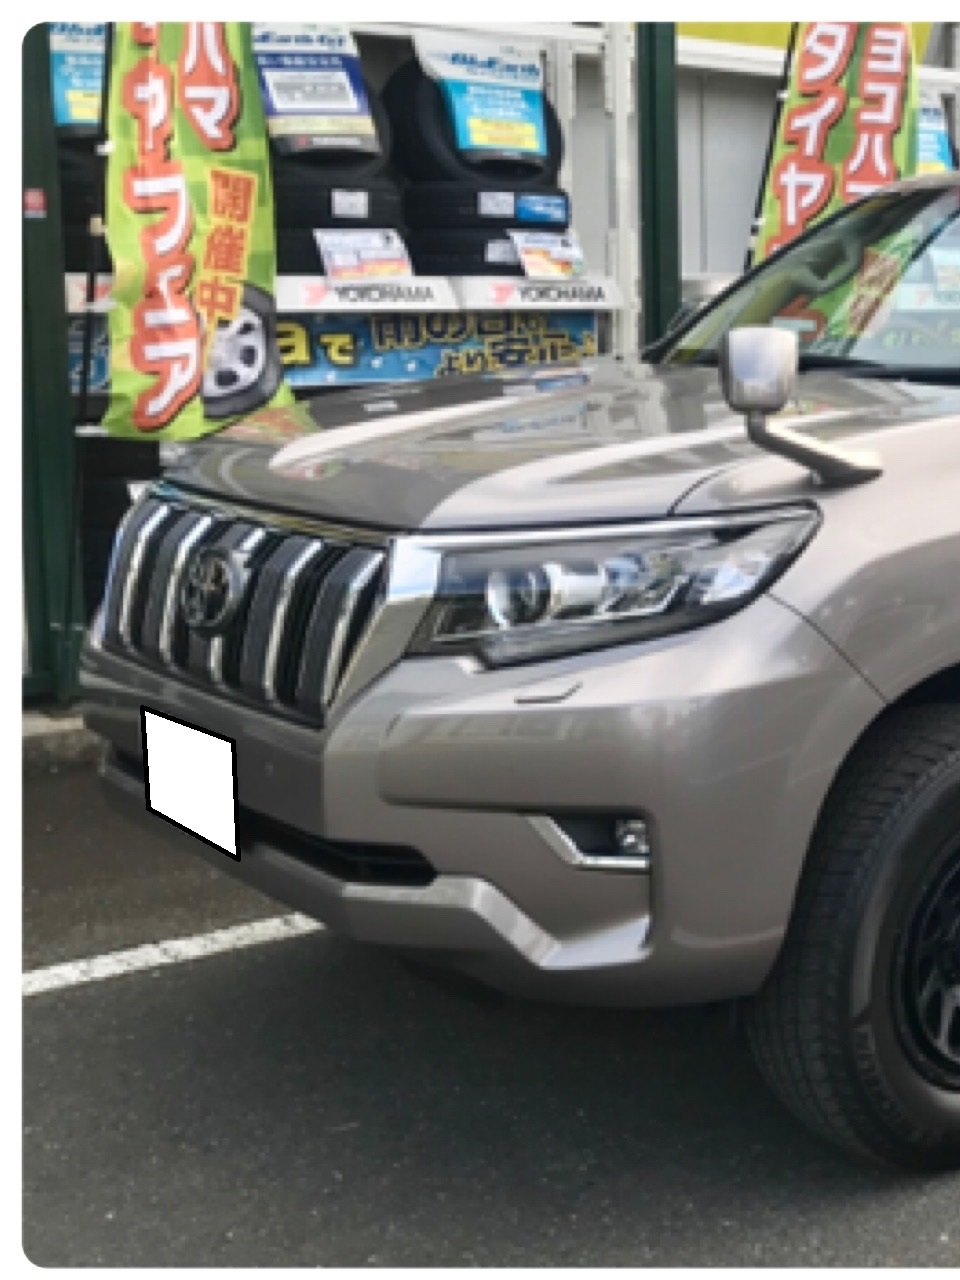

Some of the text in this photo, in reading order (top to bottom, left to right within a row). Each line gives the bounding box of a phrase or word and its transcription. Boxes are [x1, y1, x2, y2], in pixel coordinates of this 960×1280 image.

[768, 23, 849, 250] タイヤ
[133, 22, 197, 415] ヤフェア
[333, 285, 436, 303] YOKOHAMA
[518, 285, 607, 304] YOKOHAMA
